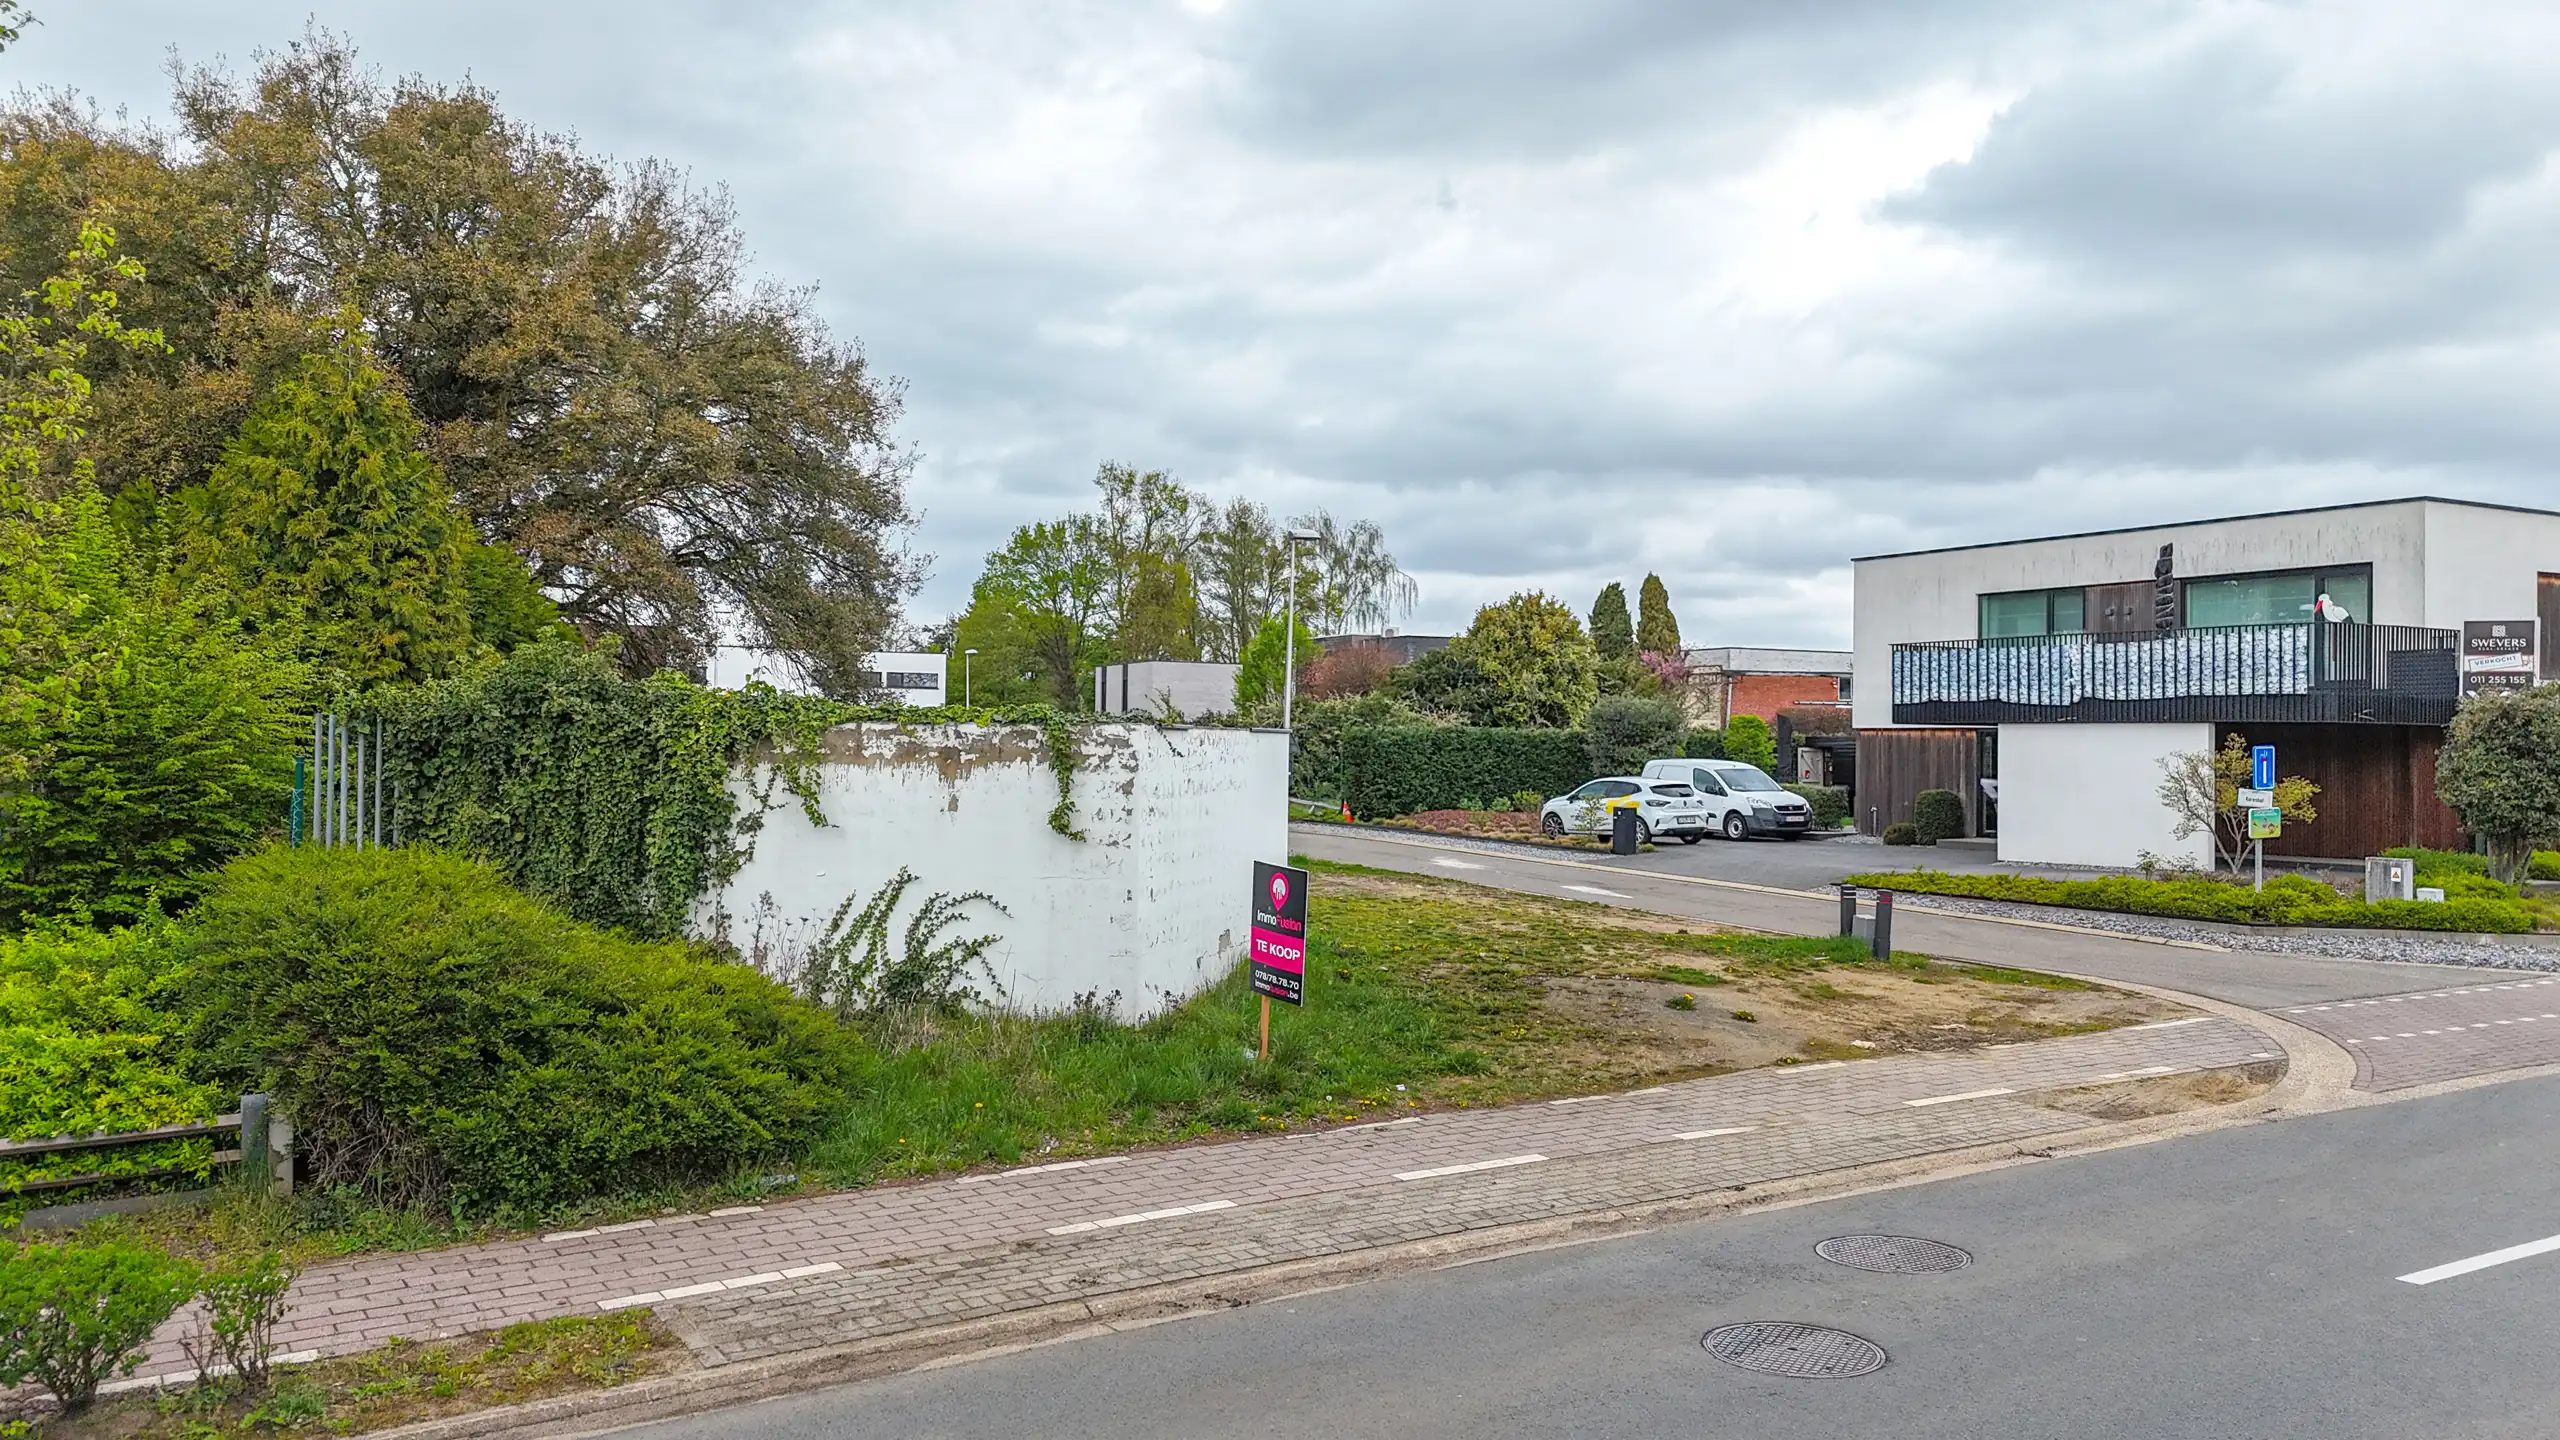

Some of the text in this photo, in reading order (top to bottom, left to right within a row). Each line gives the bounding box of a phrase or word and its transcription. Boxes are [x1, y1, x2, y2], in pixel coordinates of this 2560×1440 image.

[2471, 638, 2527, 648] SWEVERS
[2474, 655, 2517, 666] VERKOCHT
[2470, 675, 2526, 684] 011 255 155
[1256, 939, 1301, 961] TE KOOP
[1254, 969, 1300, 991] 078/78.78.70
